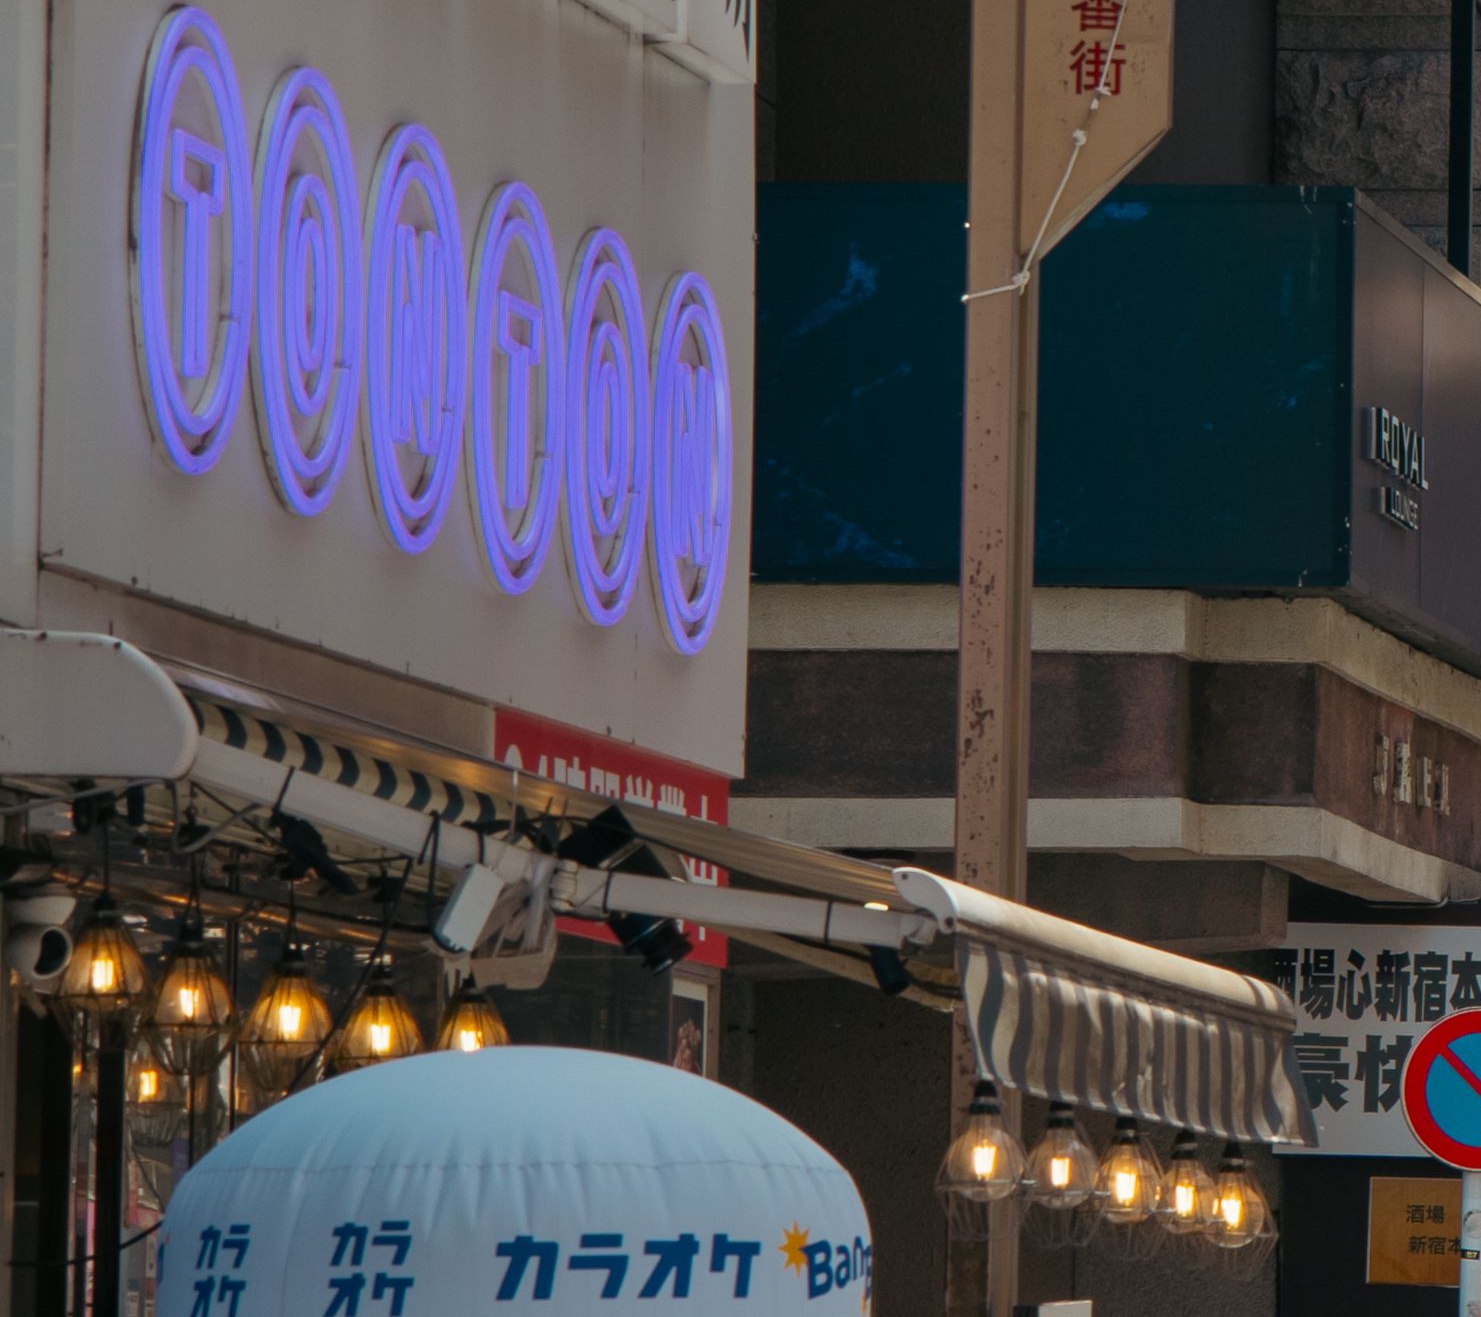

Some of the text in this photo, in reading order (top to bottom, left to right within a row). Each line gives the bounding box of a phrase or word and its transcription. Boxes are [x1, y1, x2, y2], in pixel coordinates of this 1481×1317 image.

[1406, 1204, 1445, 1224] 酒場
[195, 1223, 250, 1269] カラ
[330, 1221, 413, 1266] カラ
[494, 1231, 761, 1301] カラオケ
